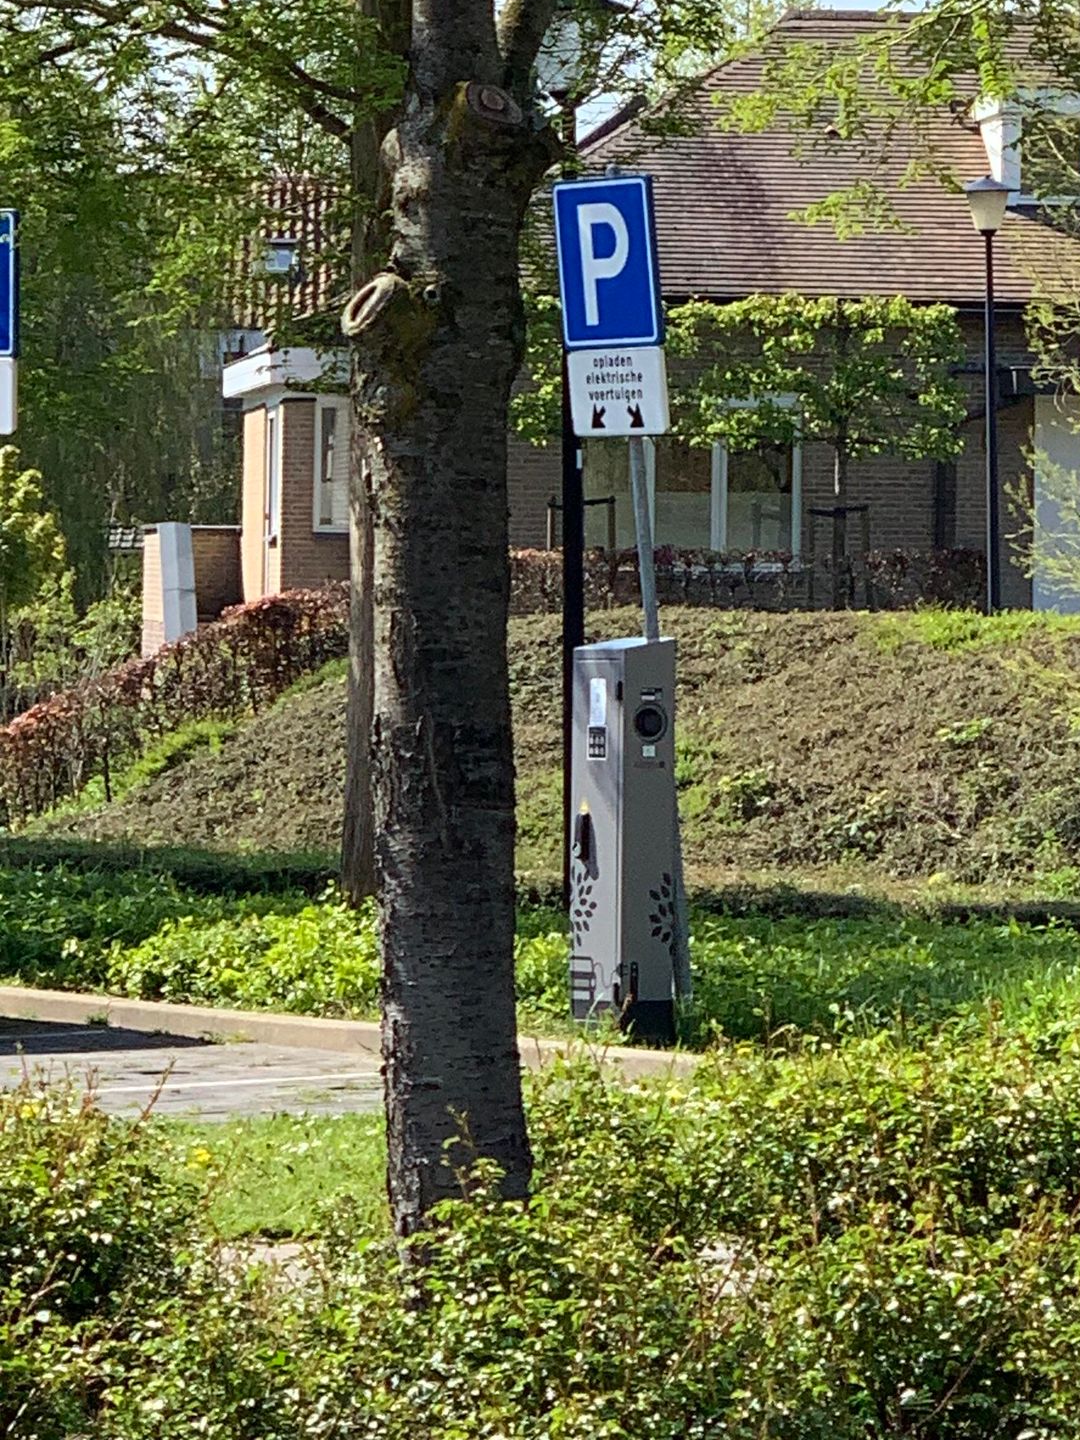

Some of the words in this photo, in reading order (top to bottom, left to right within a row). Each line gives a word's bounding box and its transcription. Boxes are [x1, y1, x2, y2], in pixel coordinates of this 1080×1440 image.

[576, 202, 629, 326] P
[593, 355, 633, 369] opladen
[586, 370, 643, 384] elektrische
[588, 387, 643, 403] voertuigen
